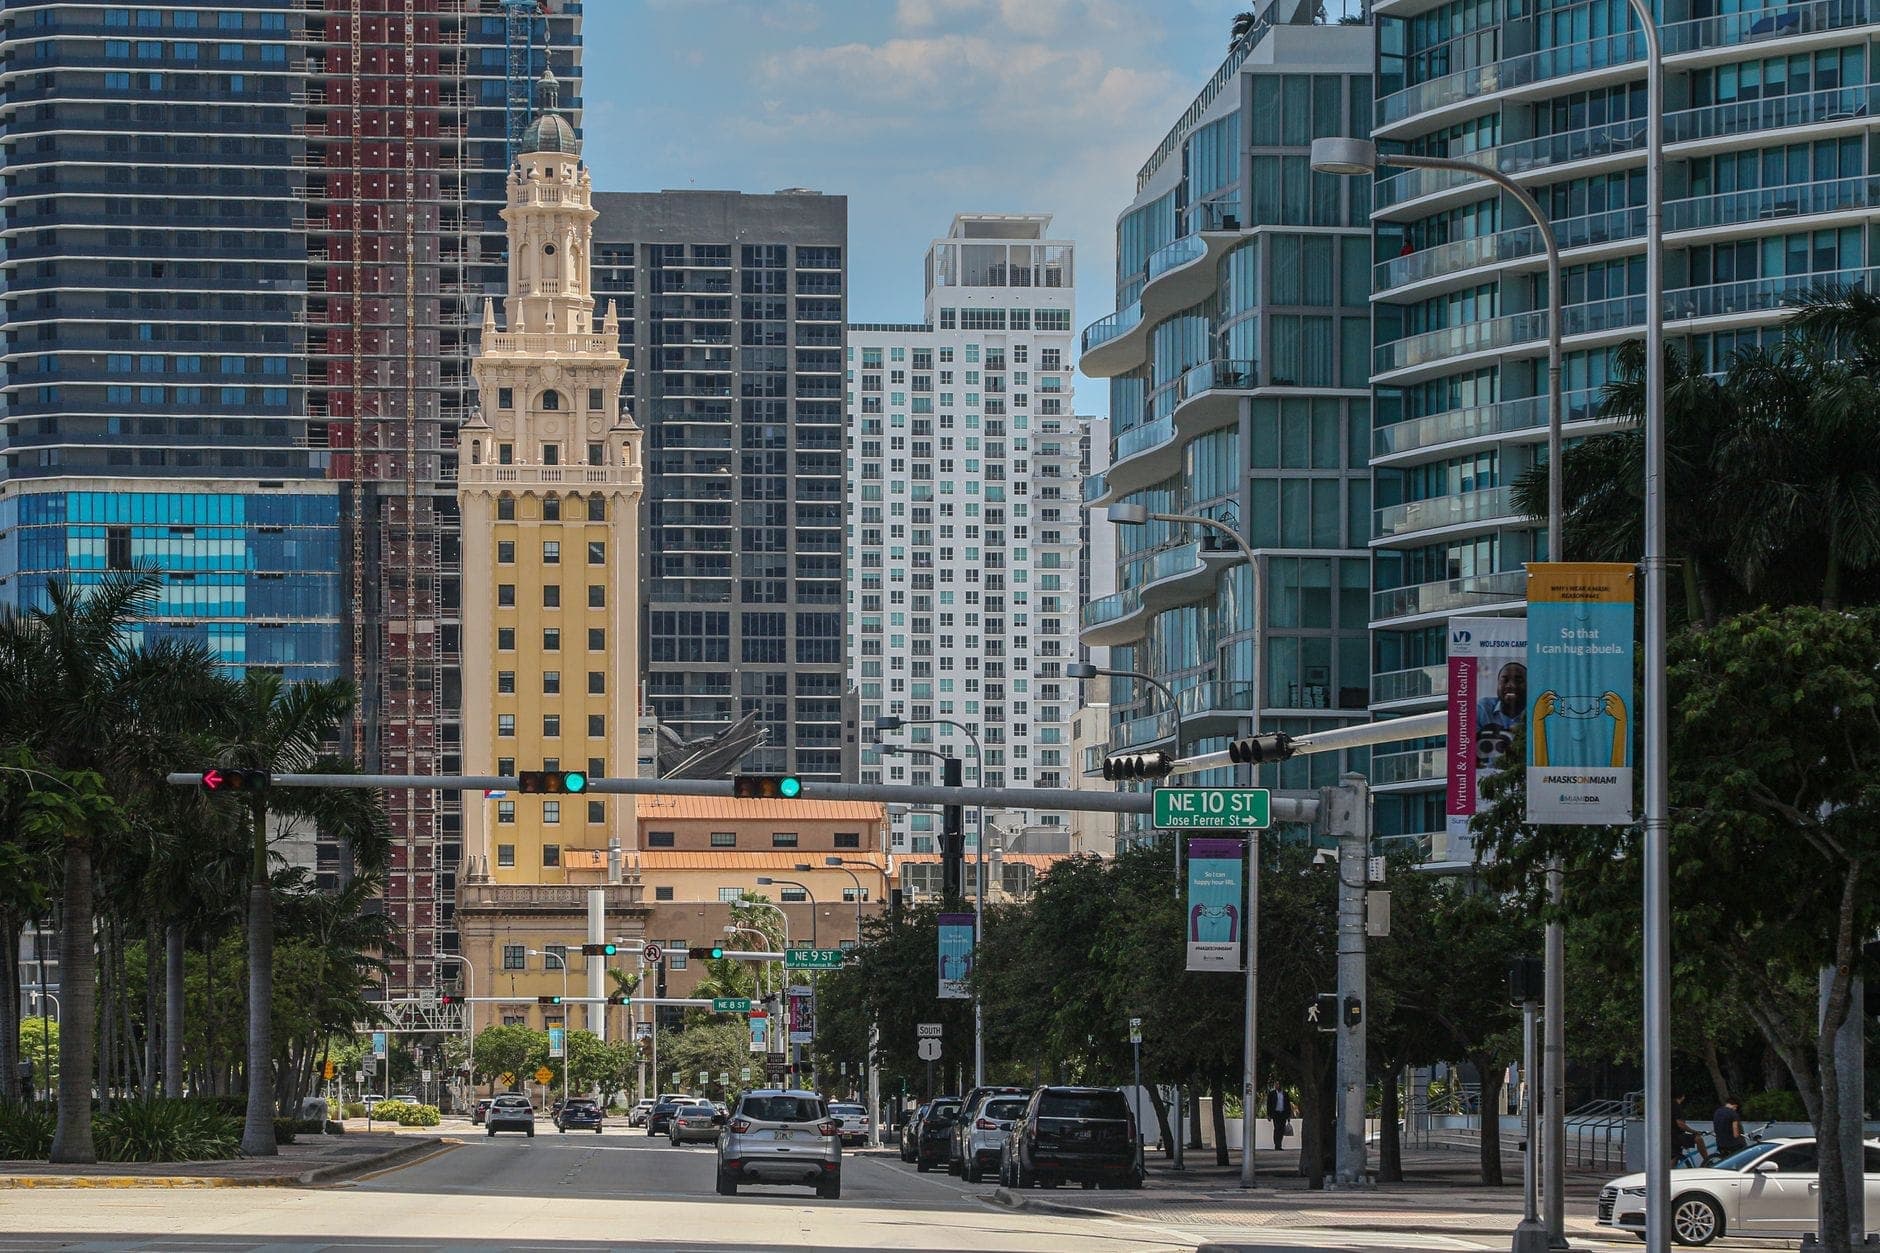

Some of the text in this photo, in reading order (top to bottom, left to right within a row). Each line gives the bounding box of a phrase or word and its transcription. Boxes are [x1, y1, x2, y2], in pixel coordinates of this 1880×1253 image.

[1561, 628, 1600, 639] So that
[1480, 640, 1509, 648] WOLFSON
[1536, 643, 1625, 656] I can hug abuela.
[1457, 661, 1472, 699] Reality
[1457, 700, 1471, 758] Augmented
[1457, 761, 1467, 771] &
[1542, 775, 1617, 785] #MASKSONMIAMI
[1456, 774, 1467, 810] Virtual
[1169, 791, 1254, 813] NE 10 ST
[1166, 814, 1240, 826] Jose Ferrer St
[795, 950, 834, 962] NE 9 ST
[730, 1001, 734, 1009] 8
[920, 1026, 940, 1034] SOUTH
[928, 1043, 931, 1055] 1
